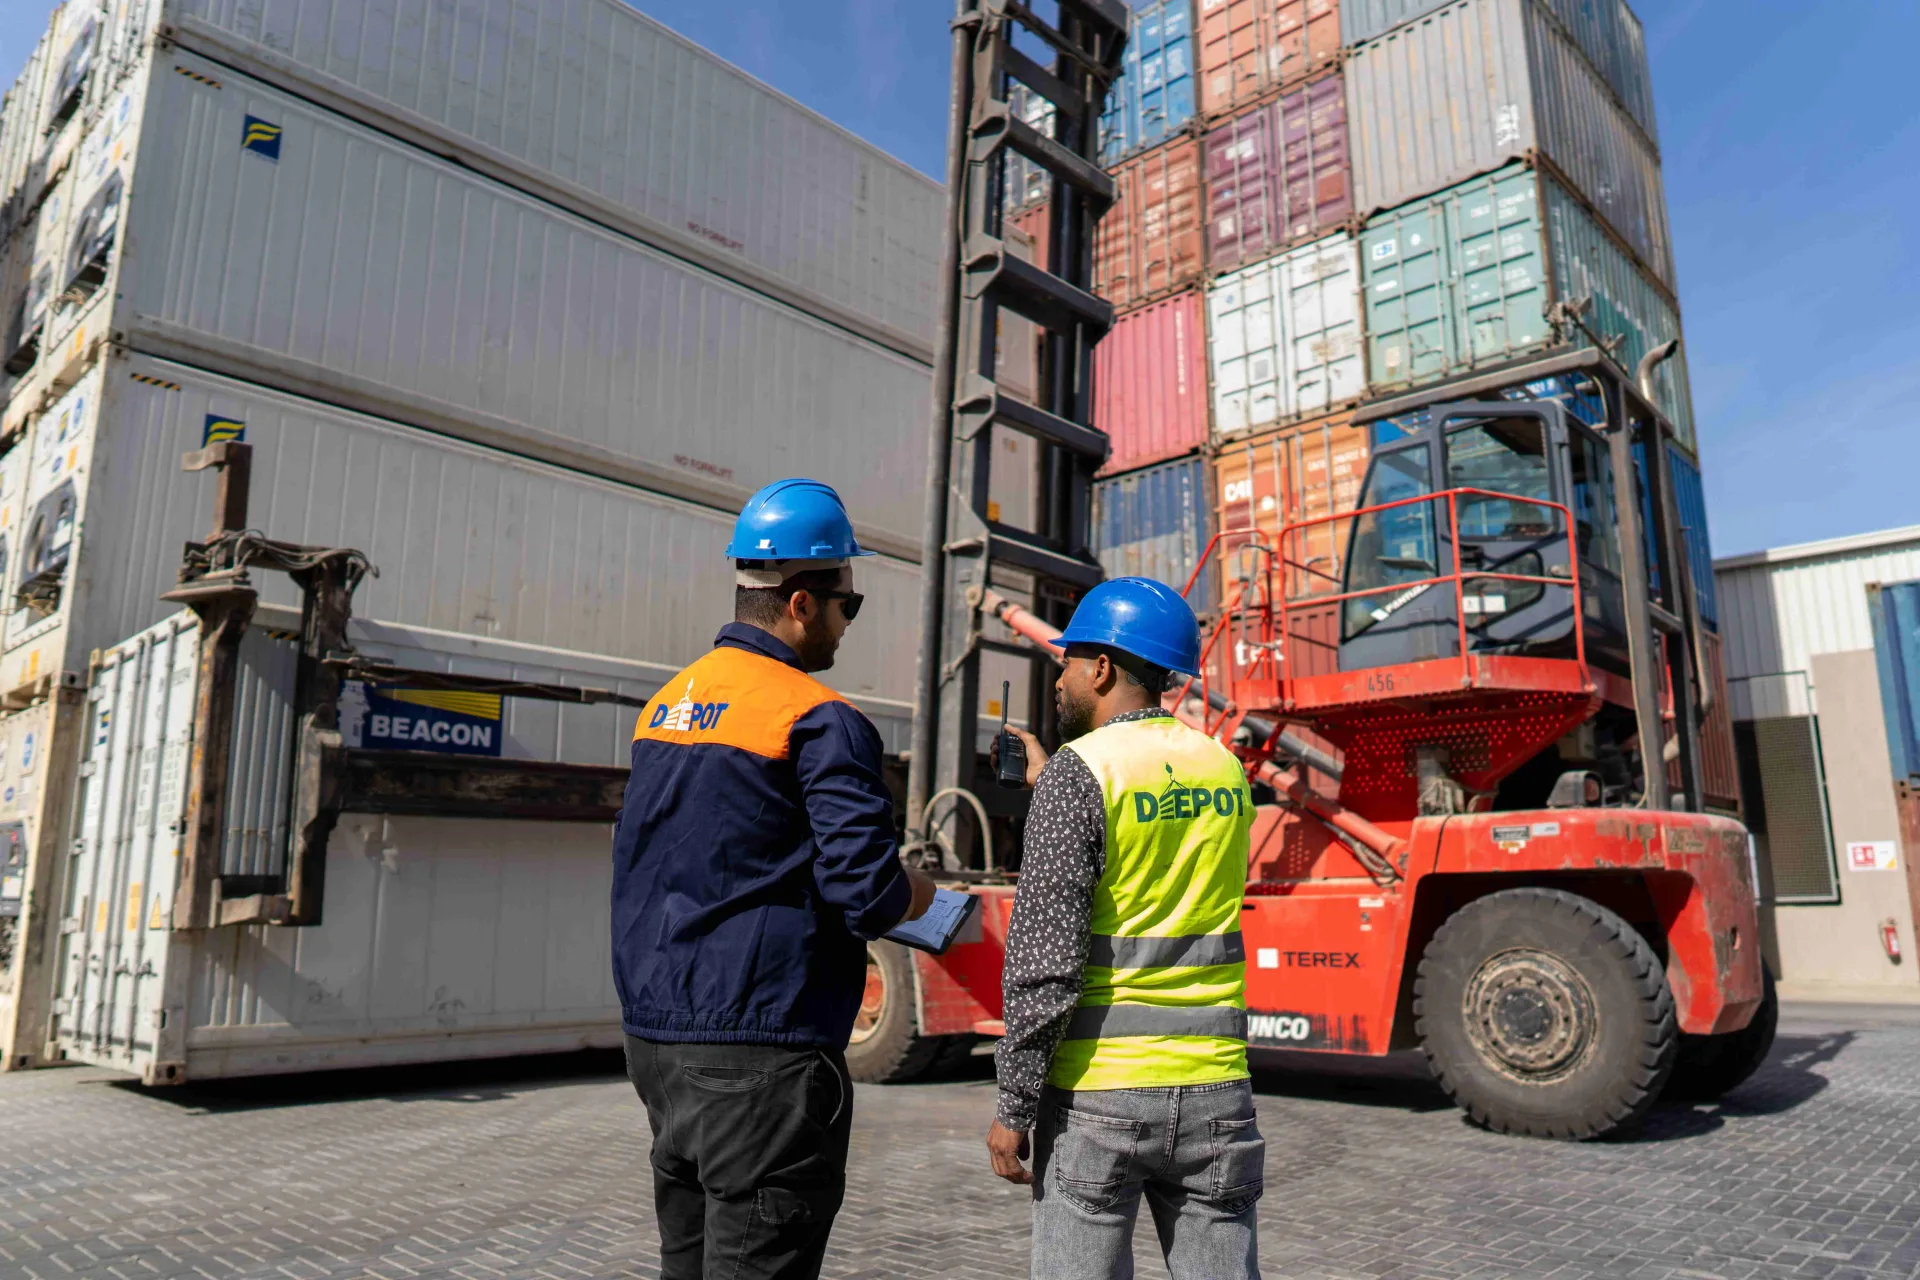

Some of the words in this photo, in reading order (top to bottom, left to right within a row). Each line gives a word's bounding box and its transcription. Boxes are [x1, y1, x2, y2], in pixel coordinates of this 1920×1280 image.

[1368, 673, 1394, 692] 456
[371, 714, 493, 748] BEACON
[648, 702, 730, 731] DEPOT
[1134, 787, 1244, 823] DEPOT
[1283, 951, 1360, 968] TEREX
